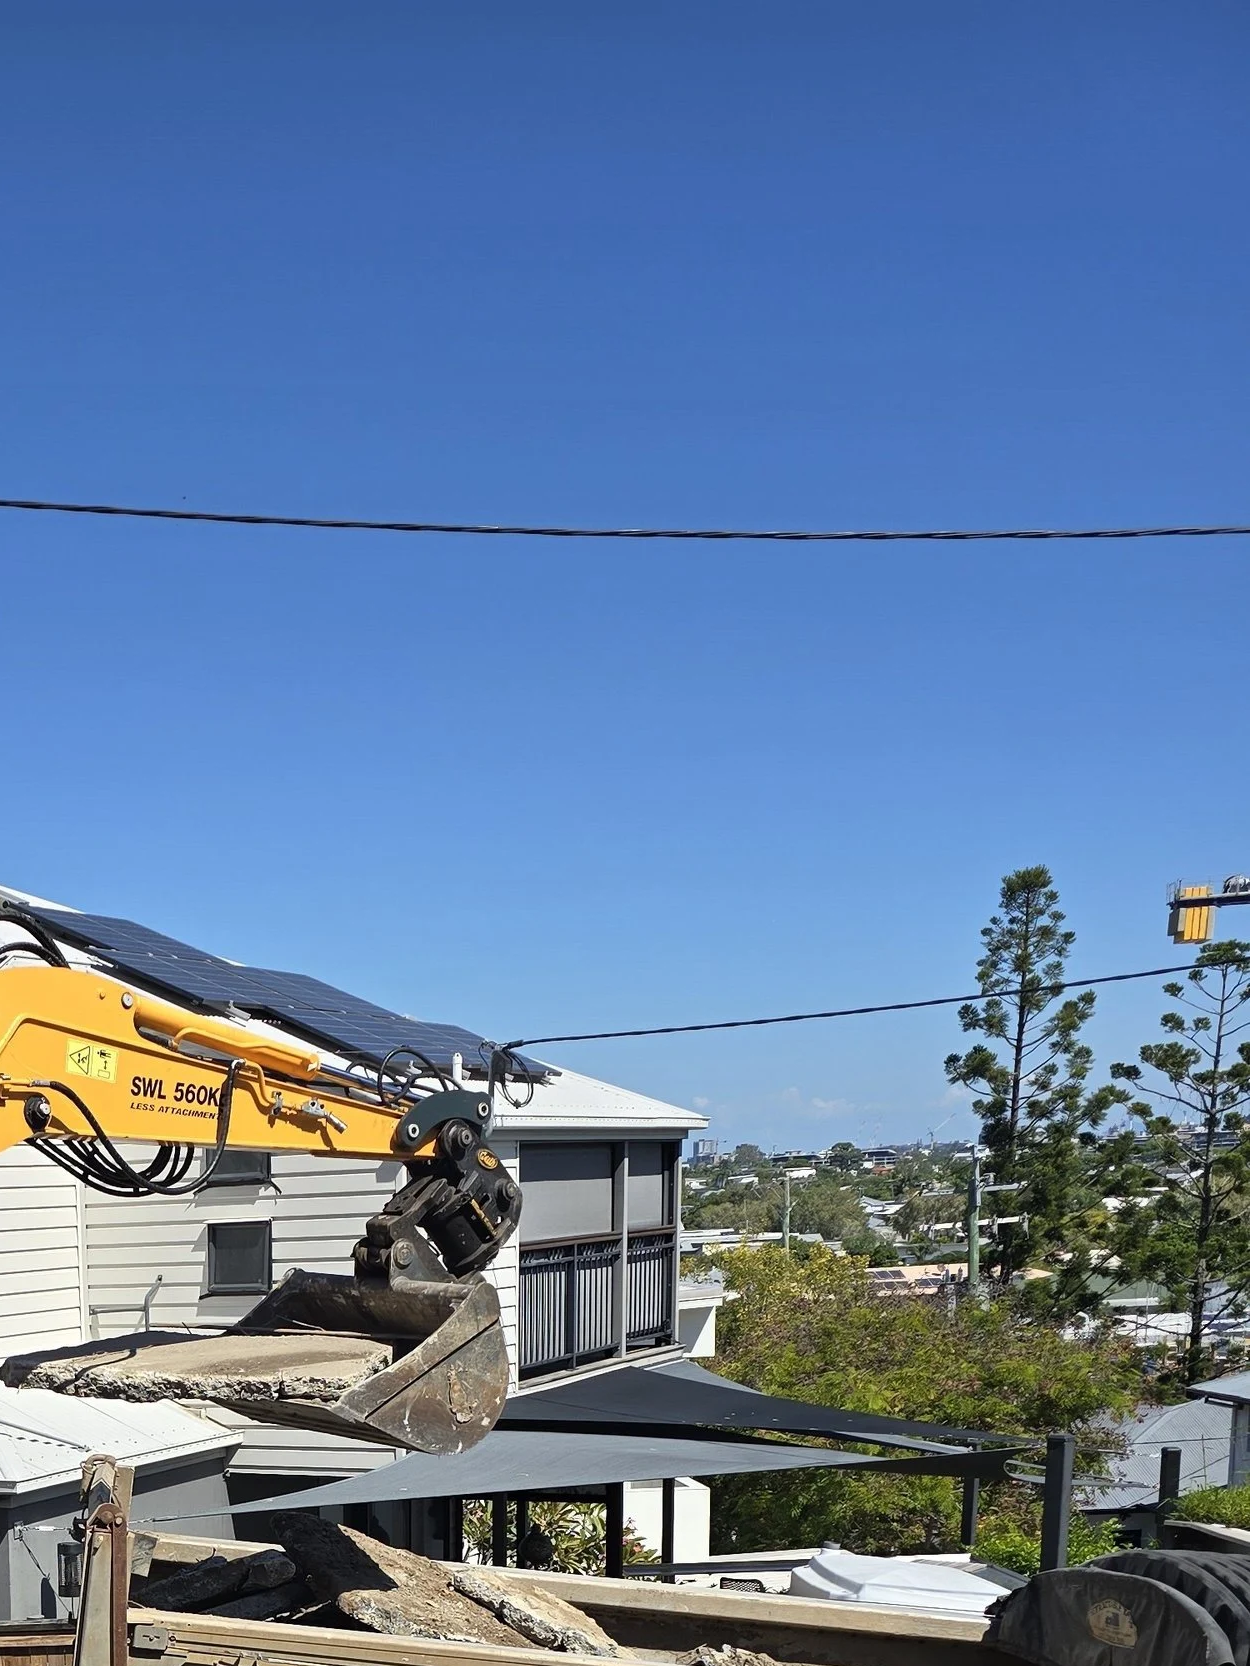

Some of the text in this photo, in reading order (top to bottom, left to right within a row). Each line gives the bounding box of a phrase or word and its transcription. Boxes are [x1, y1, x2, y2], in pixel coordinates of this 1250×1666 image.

[130, 1075, 224, 1107] SWL 560K
[130, 1102, 156, 1112] LESS
